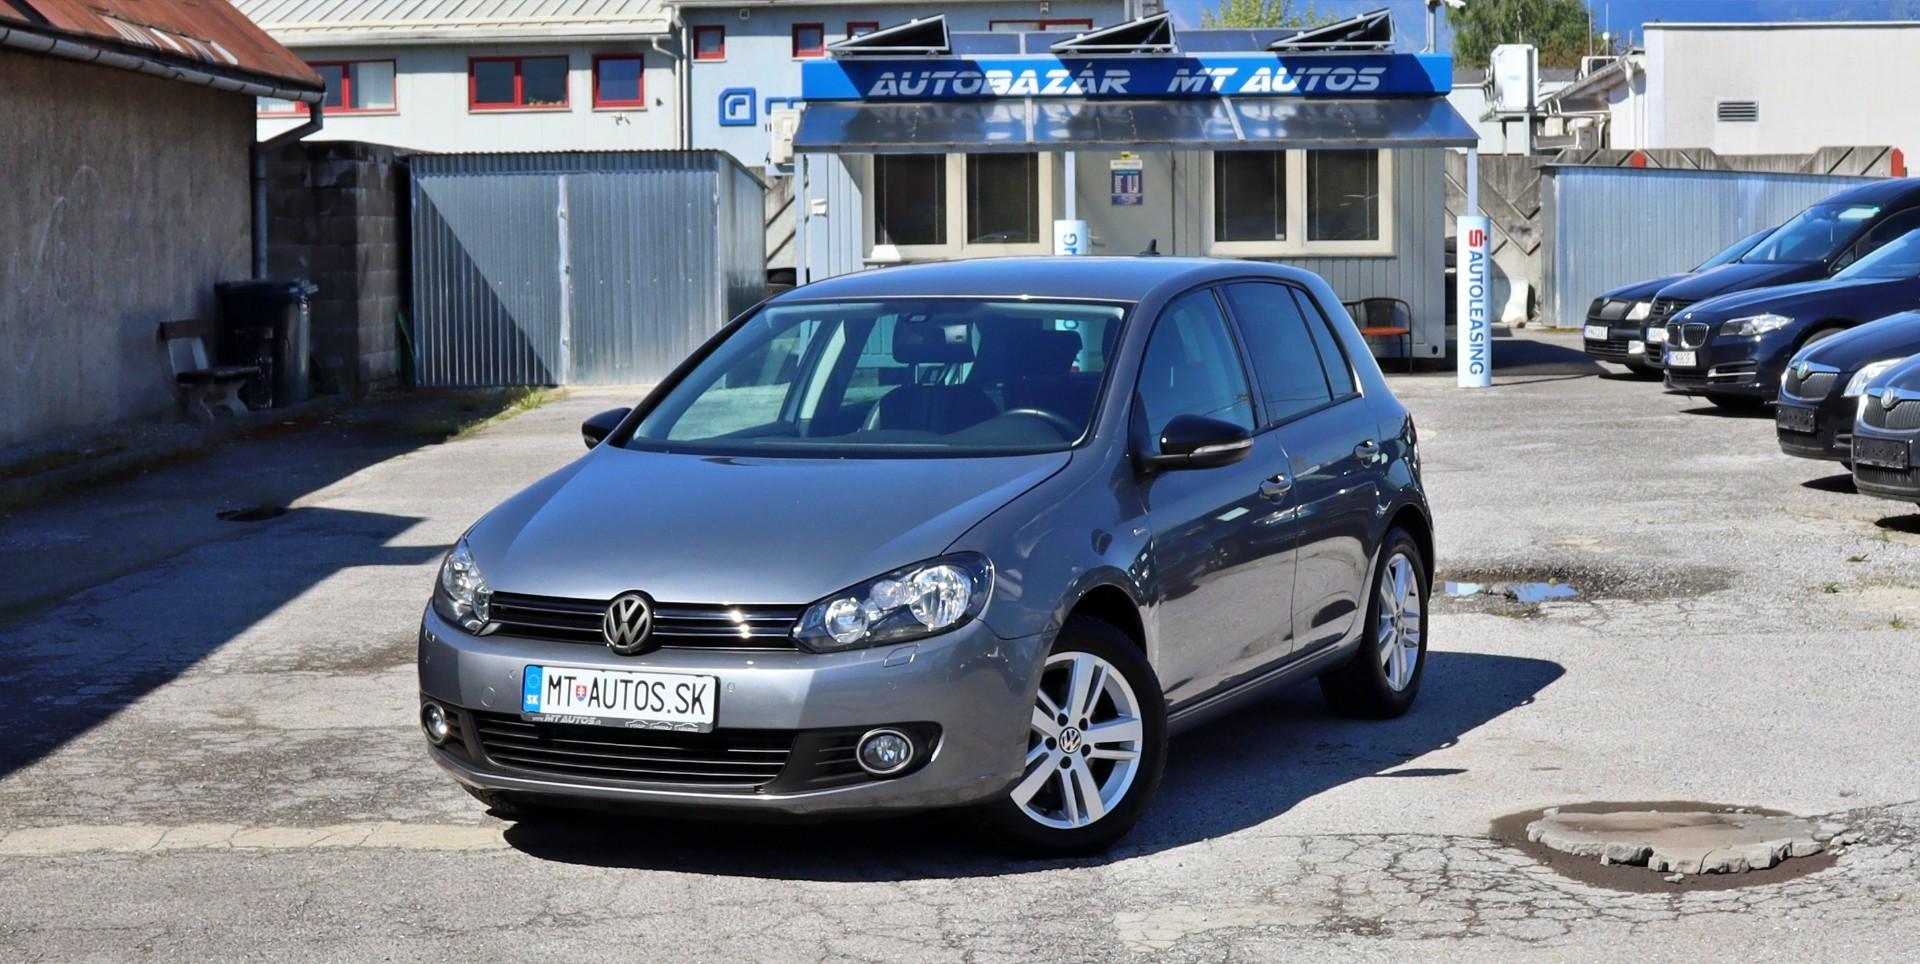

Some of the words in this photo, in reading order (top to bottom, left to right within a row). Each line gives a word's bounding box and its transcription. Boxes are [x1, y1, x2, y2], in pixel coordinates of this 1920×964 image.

[868, 62, 1131, 96] AUTOBAZÁR
[1167, 67, 1238, 93] MT
[1239, 67, 1387, 92] AUTOS
[1469, 250, 1485, 375] AUTOLEASING
[526, 694, 539, 706] SK
[547, 674, 577, 707] MT
[587, 677, 707, 716] AUTOS.SK
